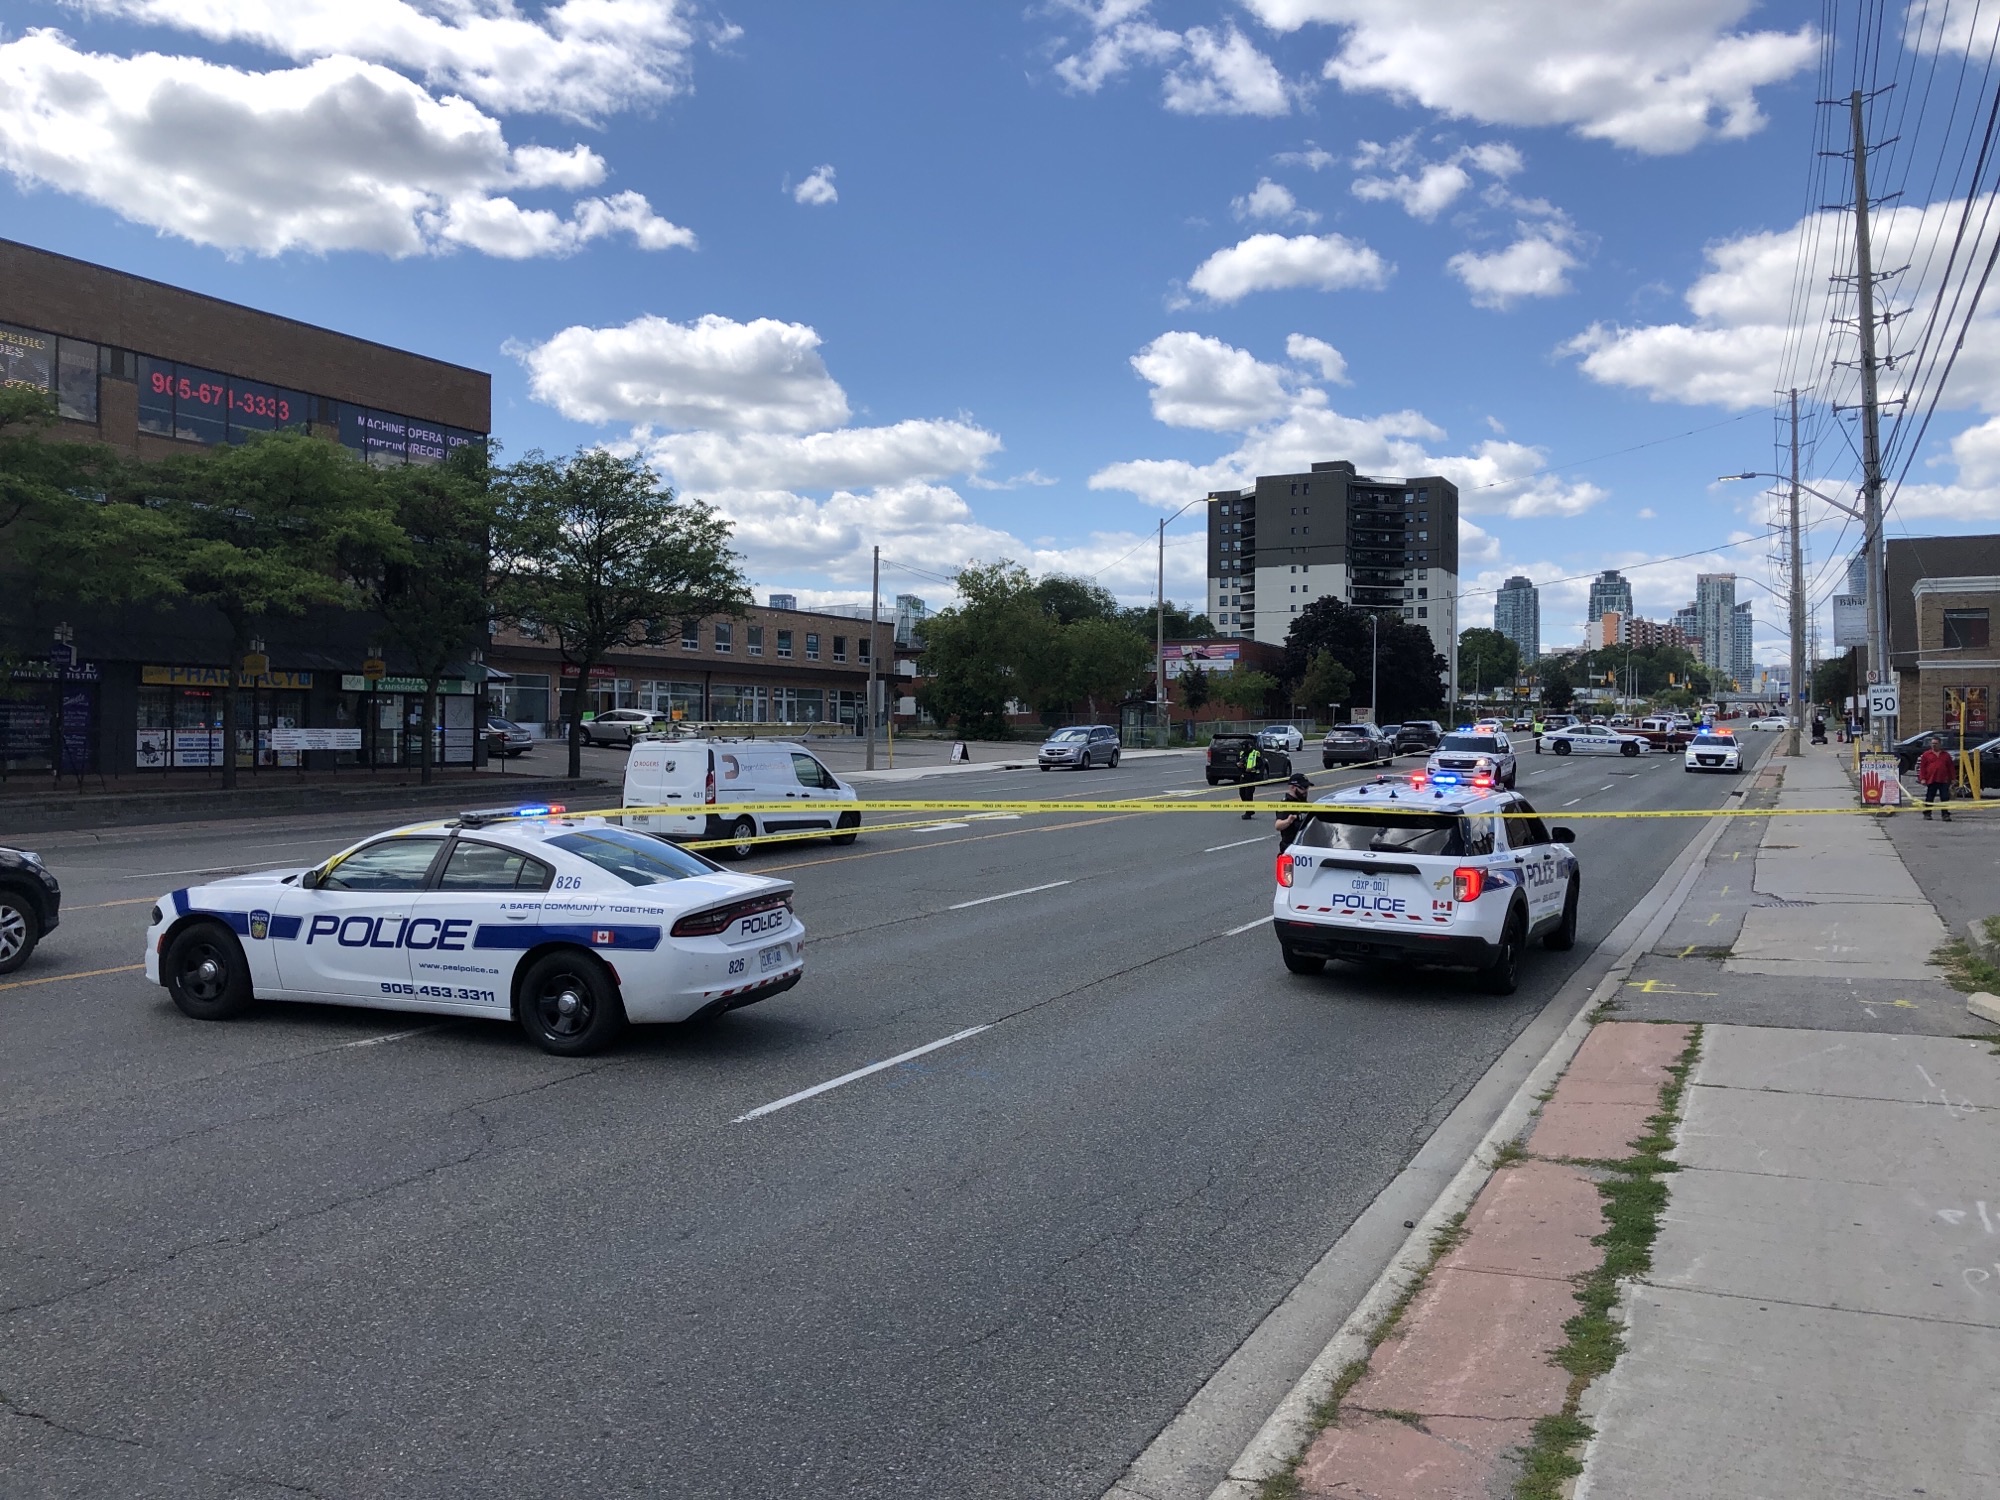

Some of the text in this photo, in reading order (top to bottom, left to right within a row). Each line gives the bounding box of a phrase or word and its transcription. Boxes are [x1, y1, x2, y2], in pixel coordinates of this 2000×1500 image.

[151, 372, 290, 421] 905-671-3333
[357, 416, 406, 437] MACHINE
[47, 672, 98, 680] DETISTRY
[1873, 697, 1895, 712] 50
[693, 791, 703, 799] 431
[1294, 856, 1313, 867] 001
[556, 876, 582, 889] 826
[1526, 860, 1555, 889] POLICE
[544, 903, 606, 912] COMMUNITY
[609, 905, 665, 915] TOGETHER
[1332, 894, 1406, 912] POLICE
[741, 911, 783, 936] POLICE
[306, 915, 473, 951] POLICE
[418, 962, 499, 975] www.peelpolice.ca
[728, 958, 745, 974] 826
[380, 982, 495, 1002] 905.453.3311
